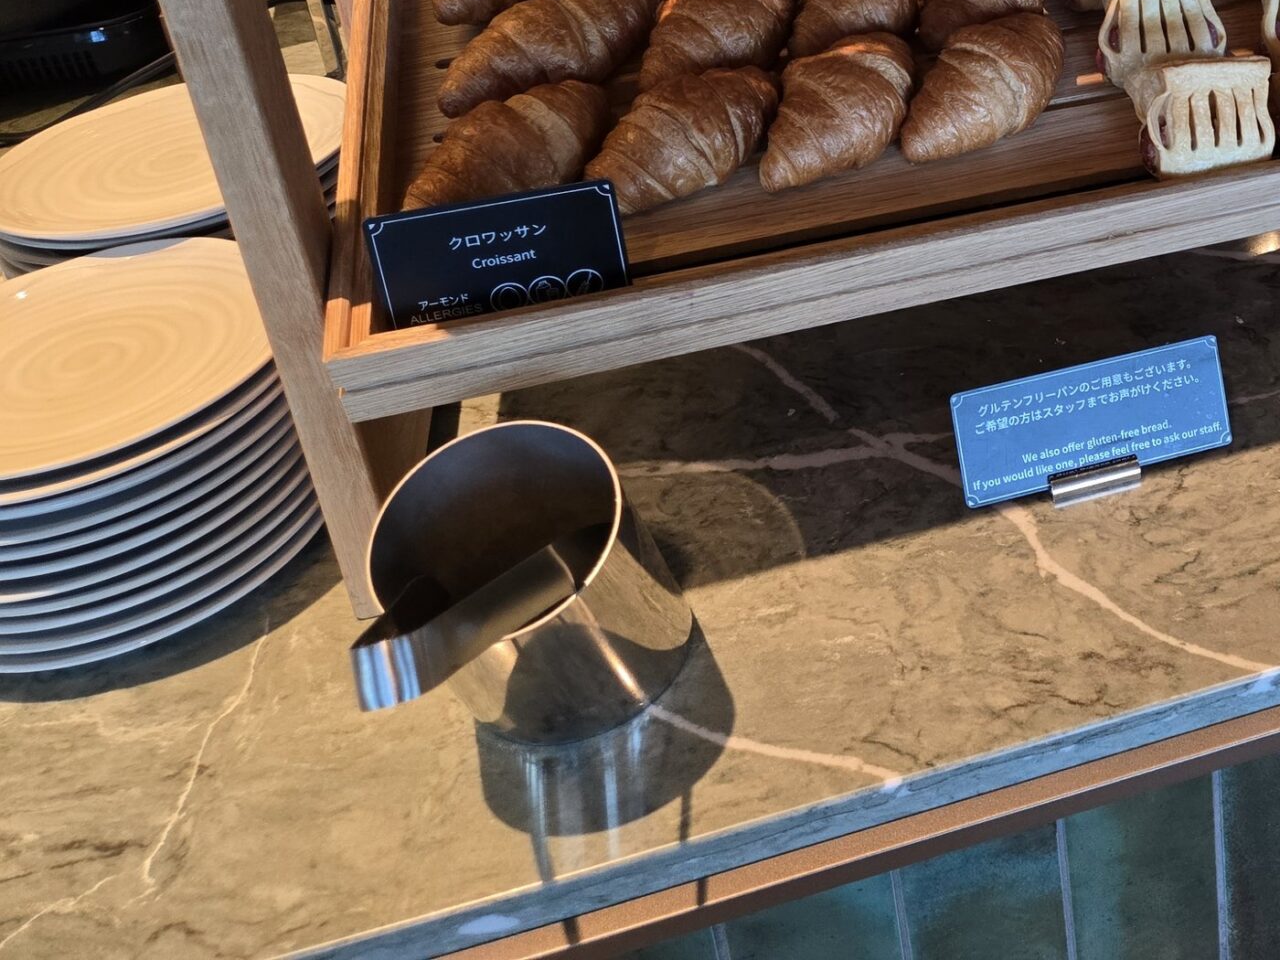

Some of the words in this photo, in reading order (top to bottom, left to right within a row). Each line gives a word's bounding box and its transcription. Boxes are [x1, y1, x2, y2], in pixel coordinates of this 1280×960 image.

[449, 223, 546, 250] クロワッサン
[471, 249, 536, 269] Croissant
[410, 303, 483, 325] ALLERGIES
[418, 293, 469, 311] アーモンド
[1022, 451, 1038, 465] We
[1040, 445, 1060, 461] also
[1062, 440, 1085, 455] offer
[1087, 427, 1140, 450] gluten-free
[1141, 419, 1173, 436] bread.
[973, 480, 982, 492] If
[982, 476, 1001, 492] you
[1003, 467, 1034, 483] would
[1036, 461, 1053, 476] like
[1055, 458, 1078, 472] one,
[1079, 449, 1110, 468] please
[1112, 443, 1130, 458] feel
[1131, 439, 1150, 454] free
[1152, 436, 1162, 448] to
[1163, 431, 1181, 445] ask
[1182, 428, 1197, 440] our
[1199, 420, 1223, 437] staff.
